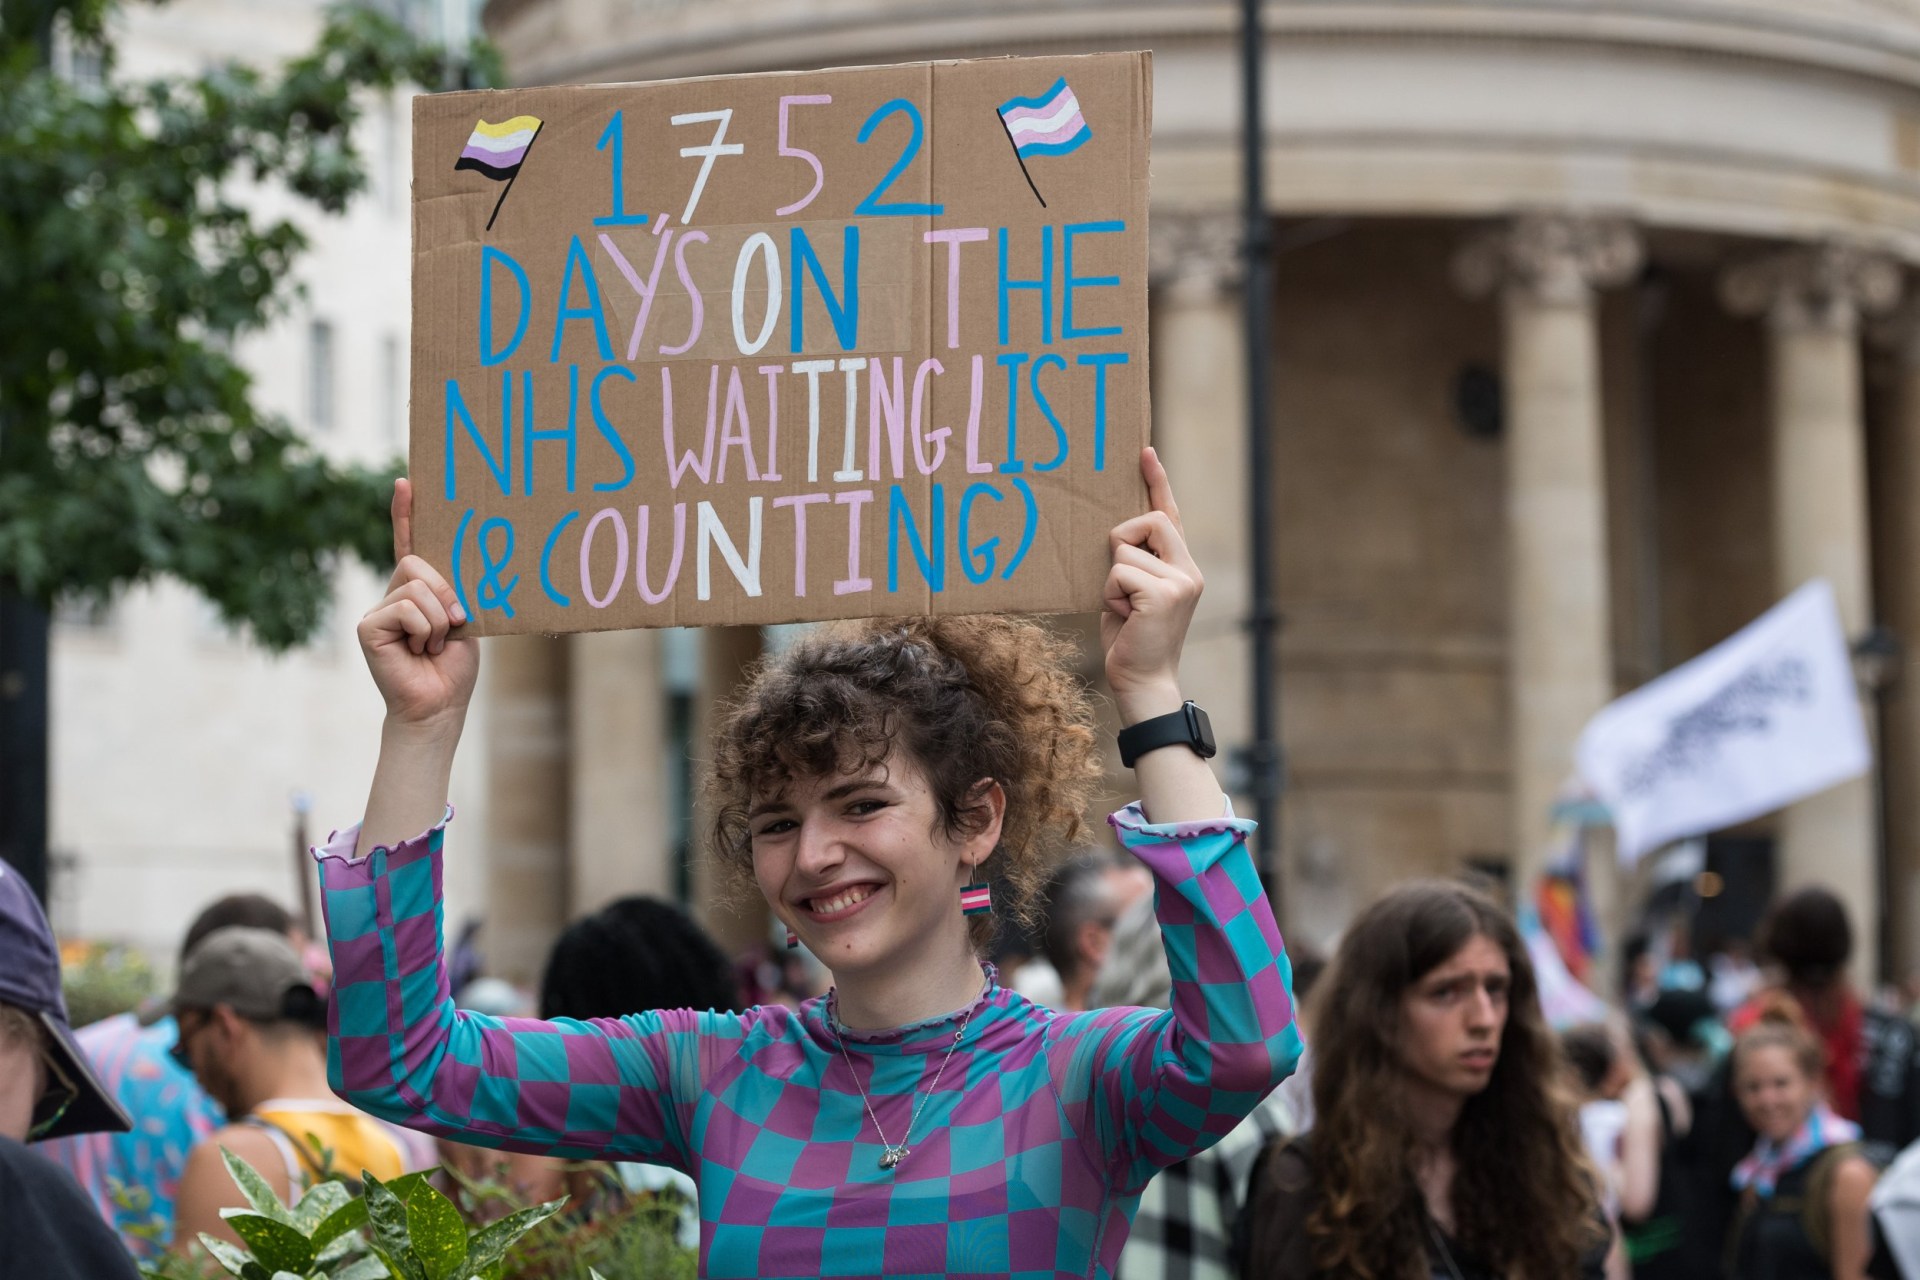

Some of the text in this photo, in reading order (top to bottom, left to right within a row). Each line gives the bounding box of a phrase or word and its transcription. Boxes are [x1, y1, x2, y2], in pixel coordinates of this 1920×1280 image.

[594, 95, 943, 225] 1752
[731, 226, 860, 355] ON
[923, 221, 1126, 348] THE
[446, 353, 1129, 501] NHS WAITING LIST
[451, 478, 1038, 622] (& COUNTING)
